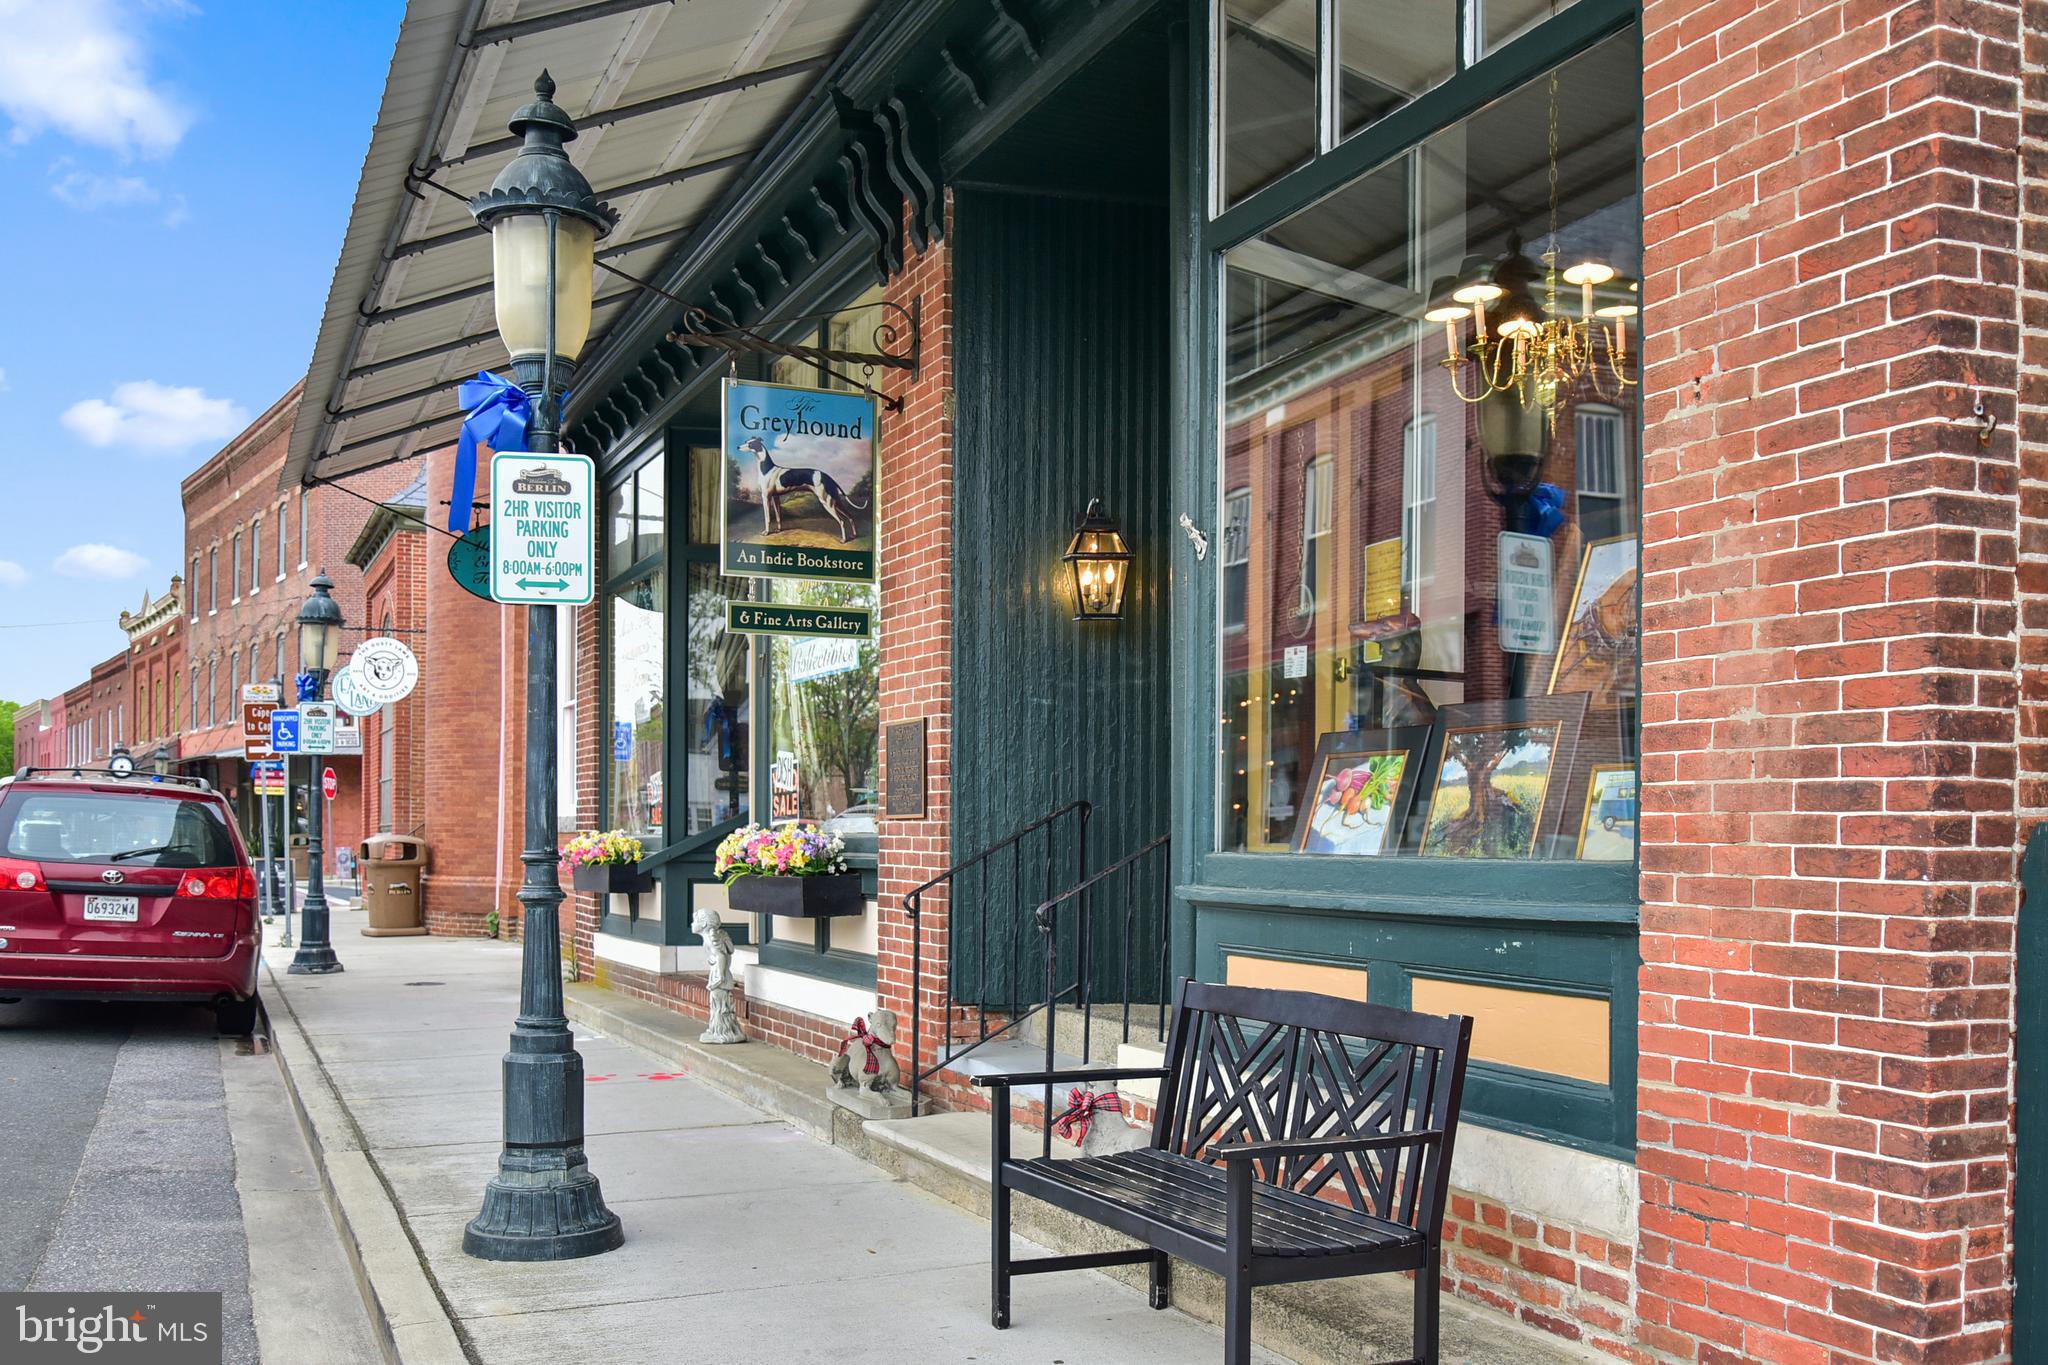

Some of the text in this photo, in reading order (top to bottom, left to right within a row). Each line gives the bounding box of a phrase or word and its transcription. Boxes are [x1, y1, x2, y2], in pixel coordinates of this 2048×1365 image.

[784, 395, 821, 413] The
[740, 404, 863, 443] Greyhound
[517, 482, 567, 493] BERLIN
[504, 499, 582, 520] 2HR VISITOR
[516, 519, 569, 539] PARKING
[527, 540, 558, 559] ONLY
[502, 559, 583, 577] 8:00AM-6:00PM
[737, 549, 864, 571] An Indie Bookstore
[739, 610, 862, 635] & Fine Arts Gallery
[251, 707, 272, 719] Cape
[247, 722, 256, 731] to
[323, 777, 337, 790] STOP
[773, 793, 799, 817] SALE
